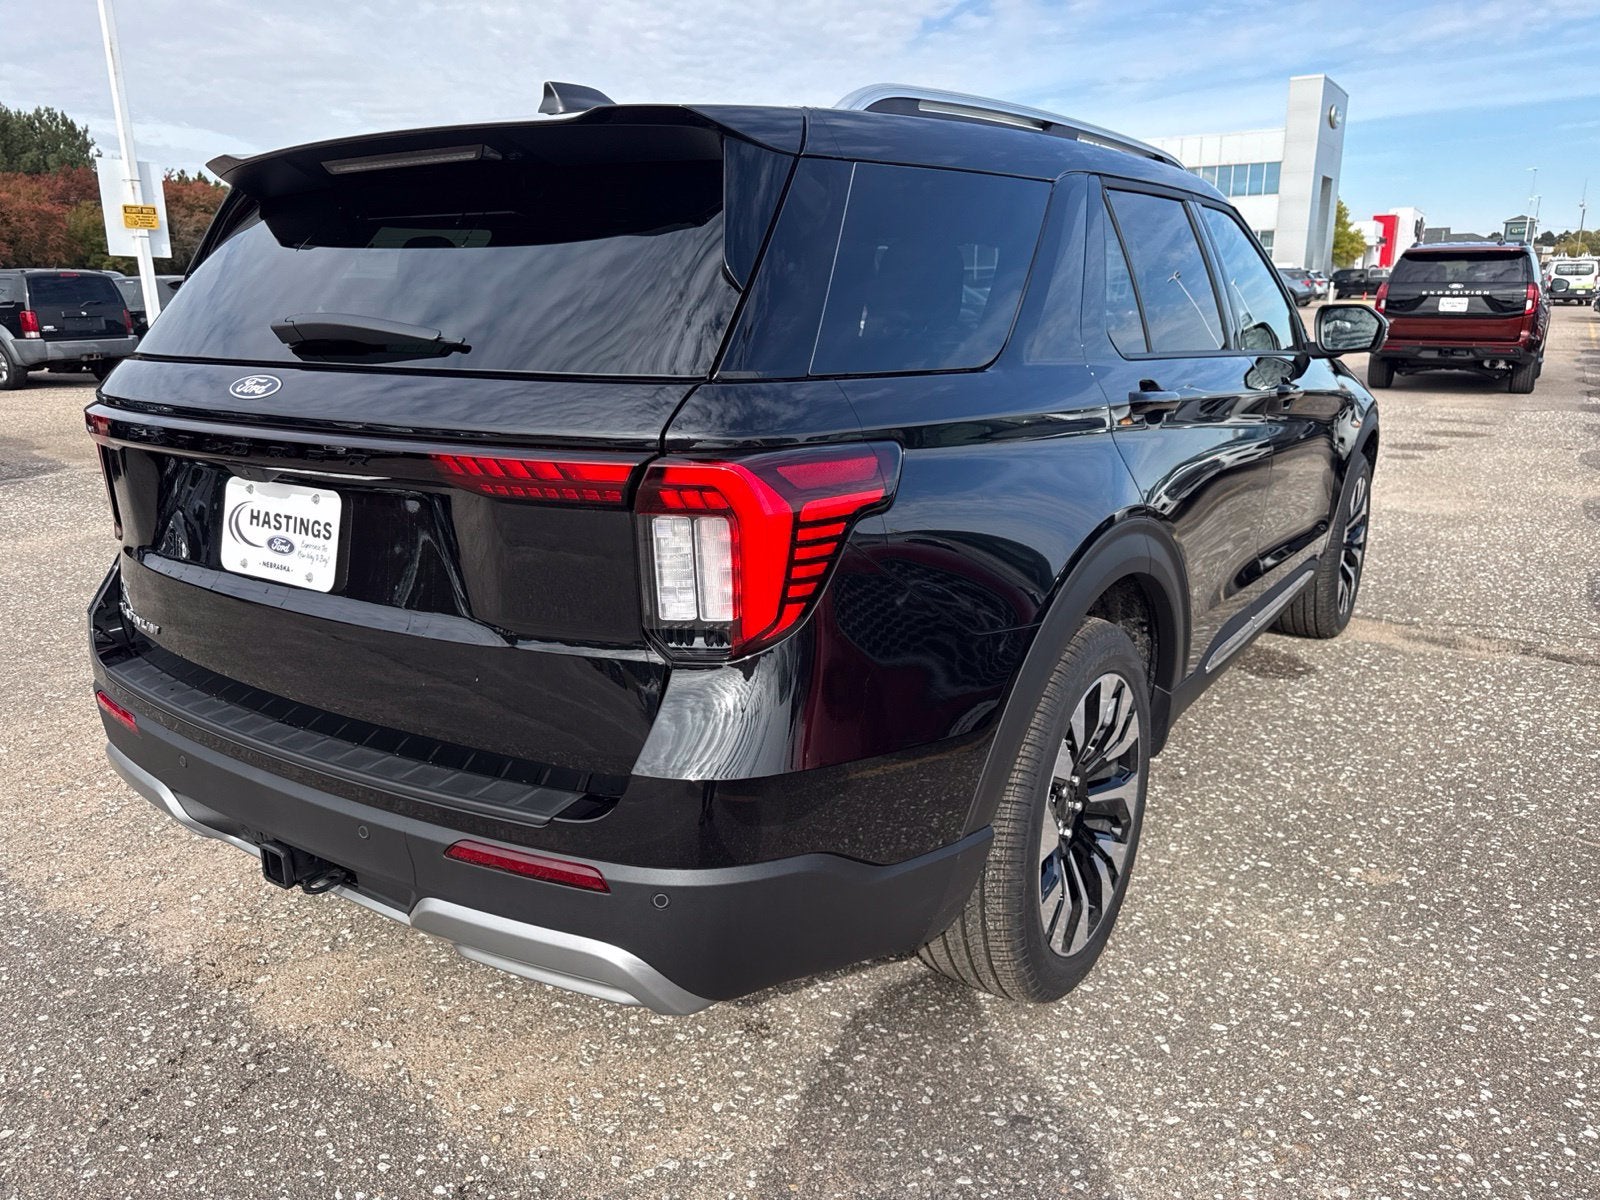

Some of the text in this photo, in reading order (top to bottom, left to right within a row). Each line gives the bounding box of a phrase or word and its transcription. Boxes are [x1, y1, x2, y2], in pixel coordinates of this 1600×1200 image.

[234, 377, 275, 396] Ford
[249, 508, 333, 540] HASTINGS
[270, 537, 293, 554] Ford
[262, 561, 290, 573] NEBRASKA
